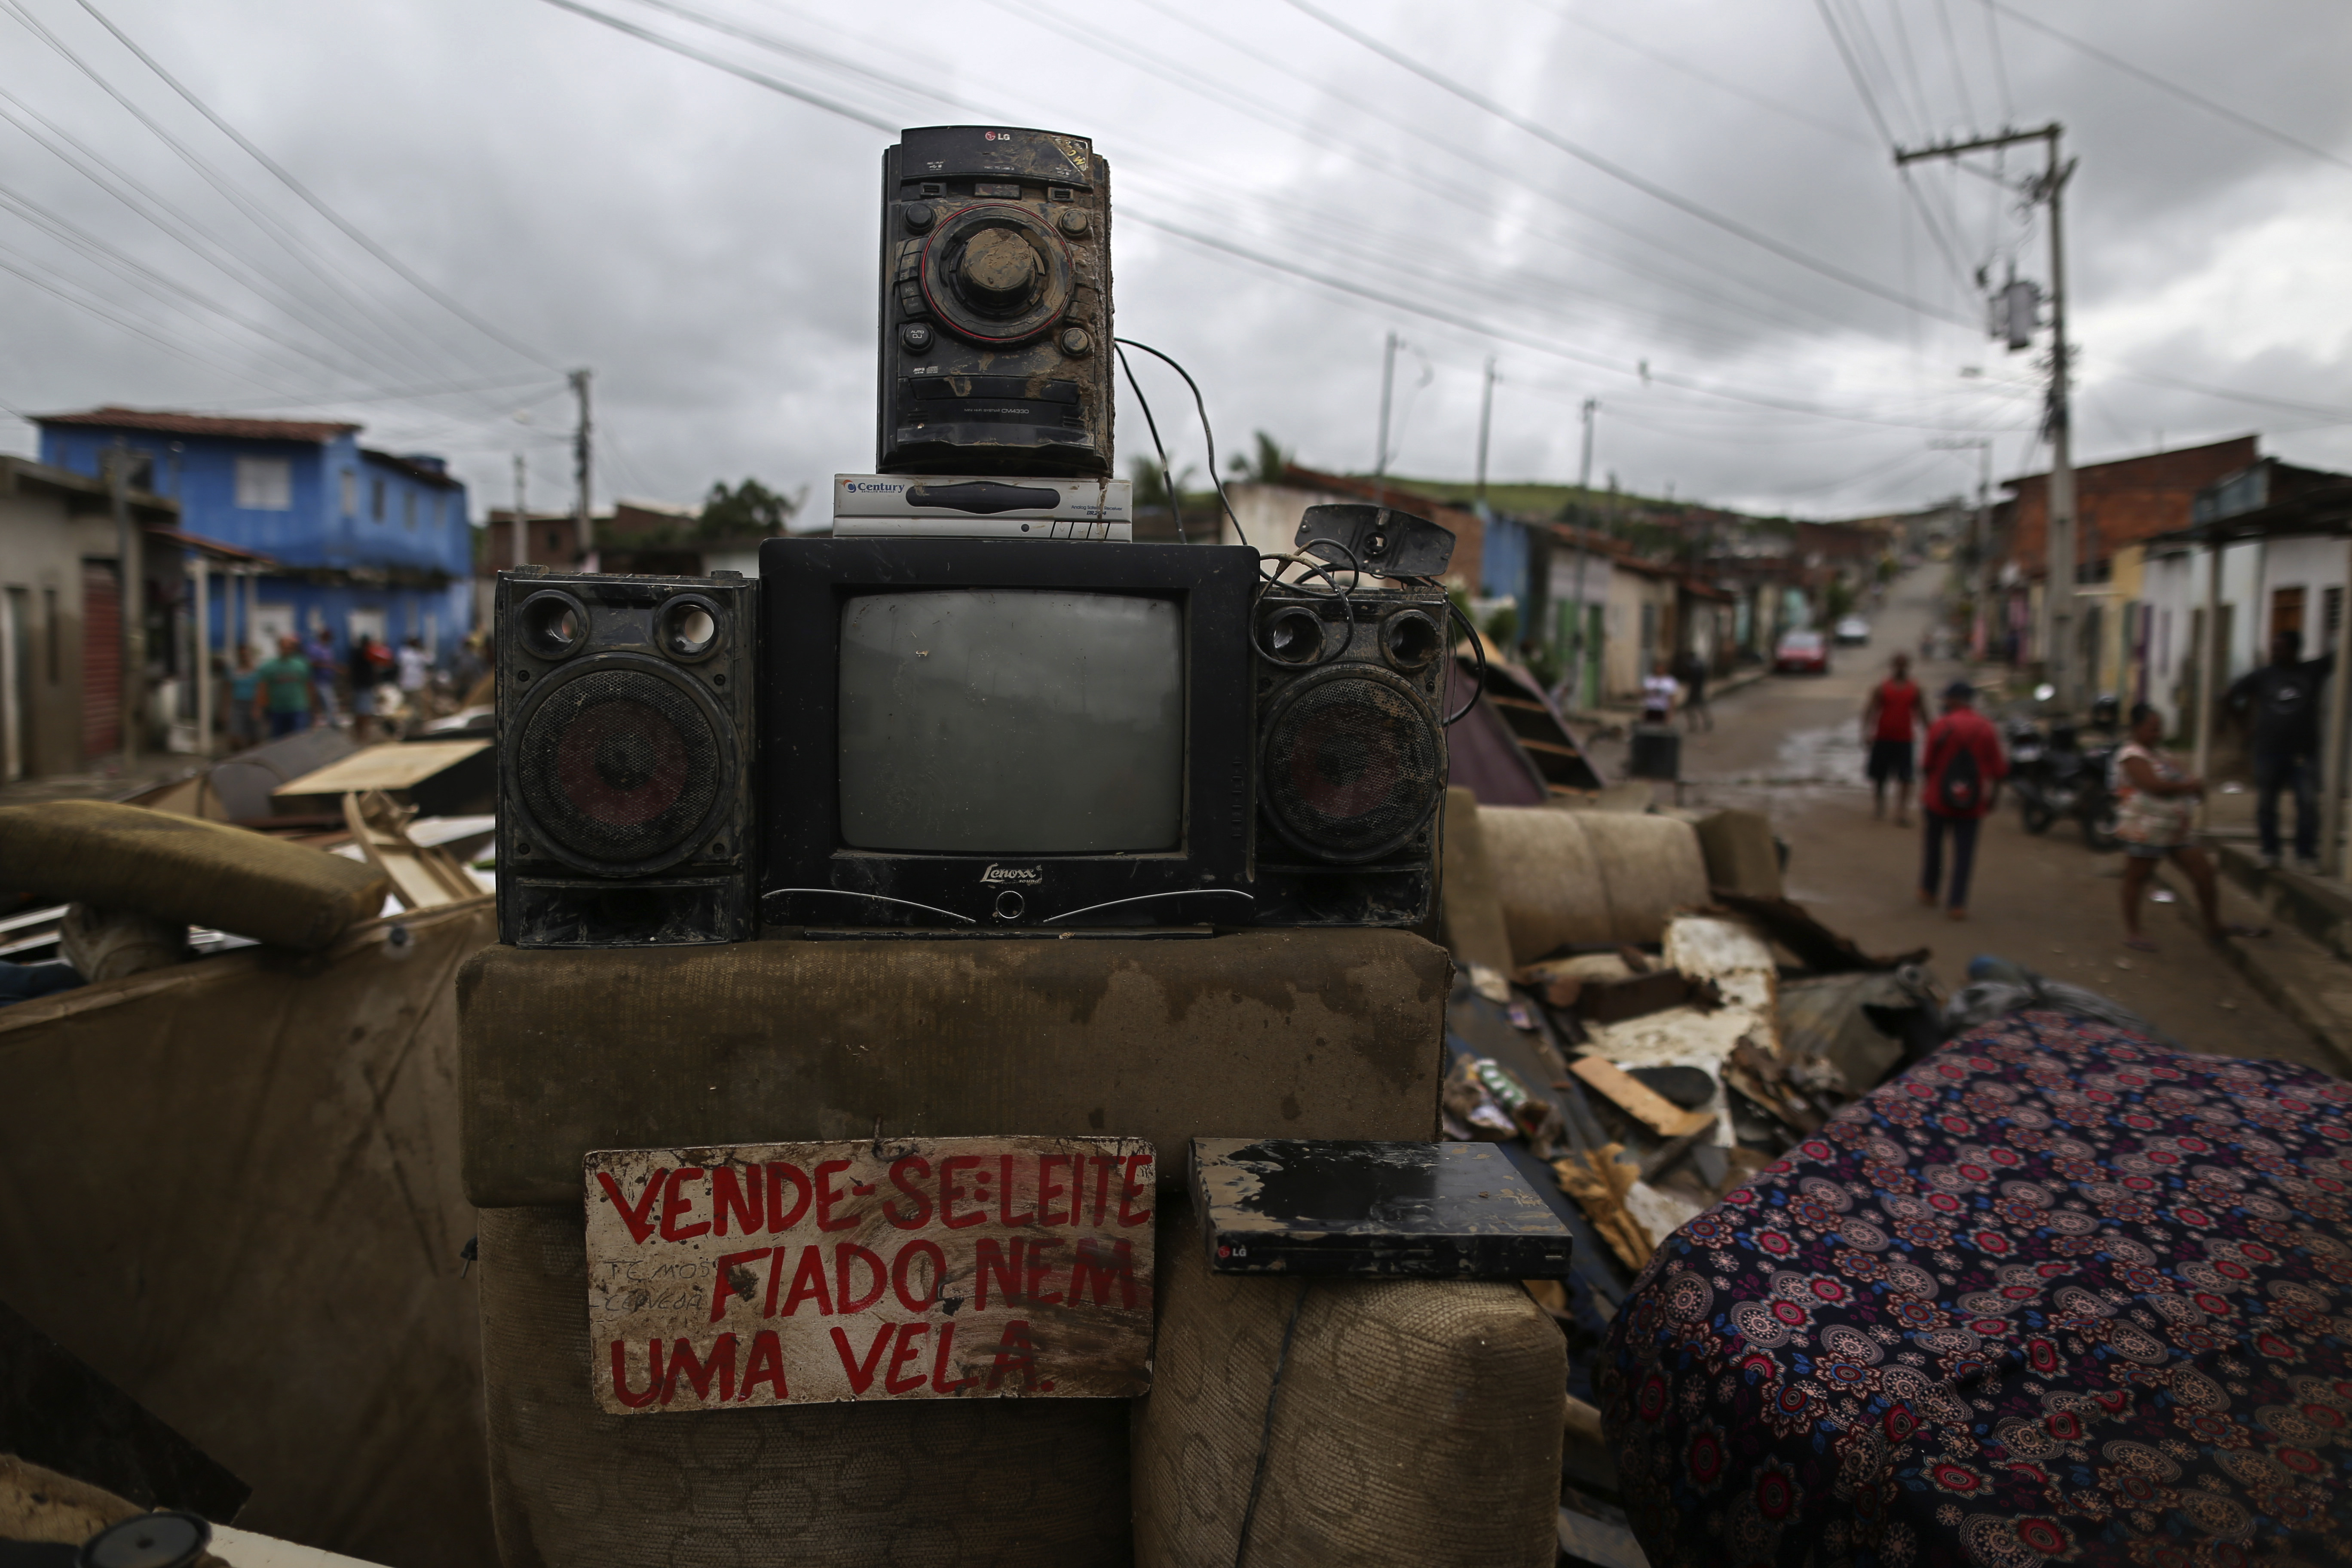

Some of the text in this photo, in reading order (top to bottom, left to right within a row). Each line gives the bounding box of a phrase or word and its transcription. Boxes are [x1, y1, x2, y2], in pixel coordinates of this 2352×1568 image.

[858, 483, 904, 493] Century
[980, 863, 1036, 882] Lenoxx
[1000, 1153, 1153, 1228] LEITE
[1232, 1248, 1246, 1256] LG
[603, 1260, 710, 1282] TEMOS
[710, 1236, 1136, 1323] FIADO NEM
[611, 1329, 789, 1408] UMA
